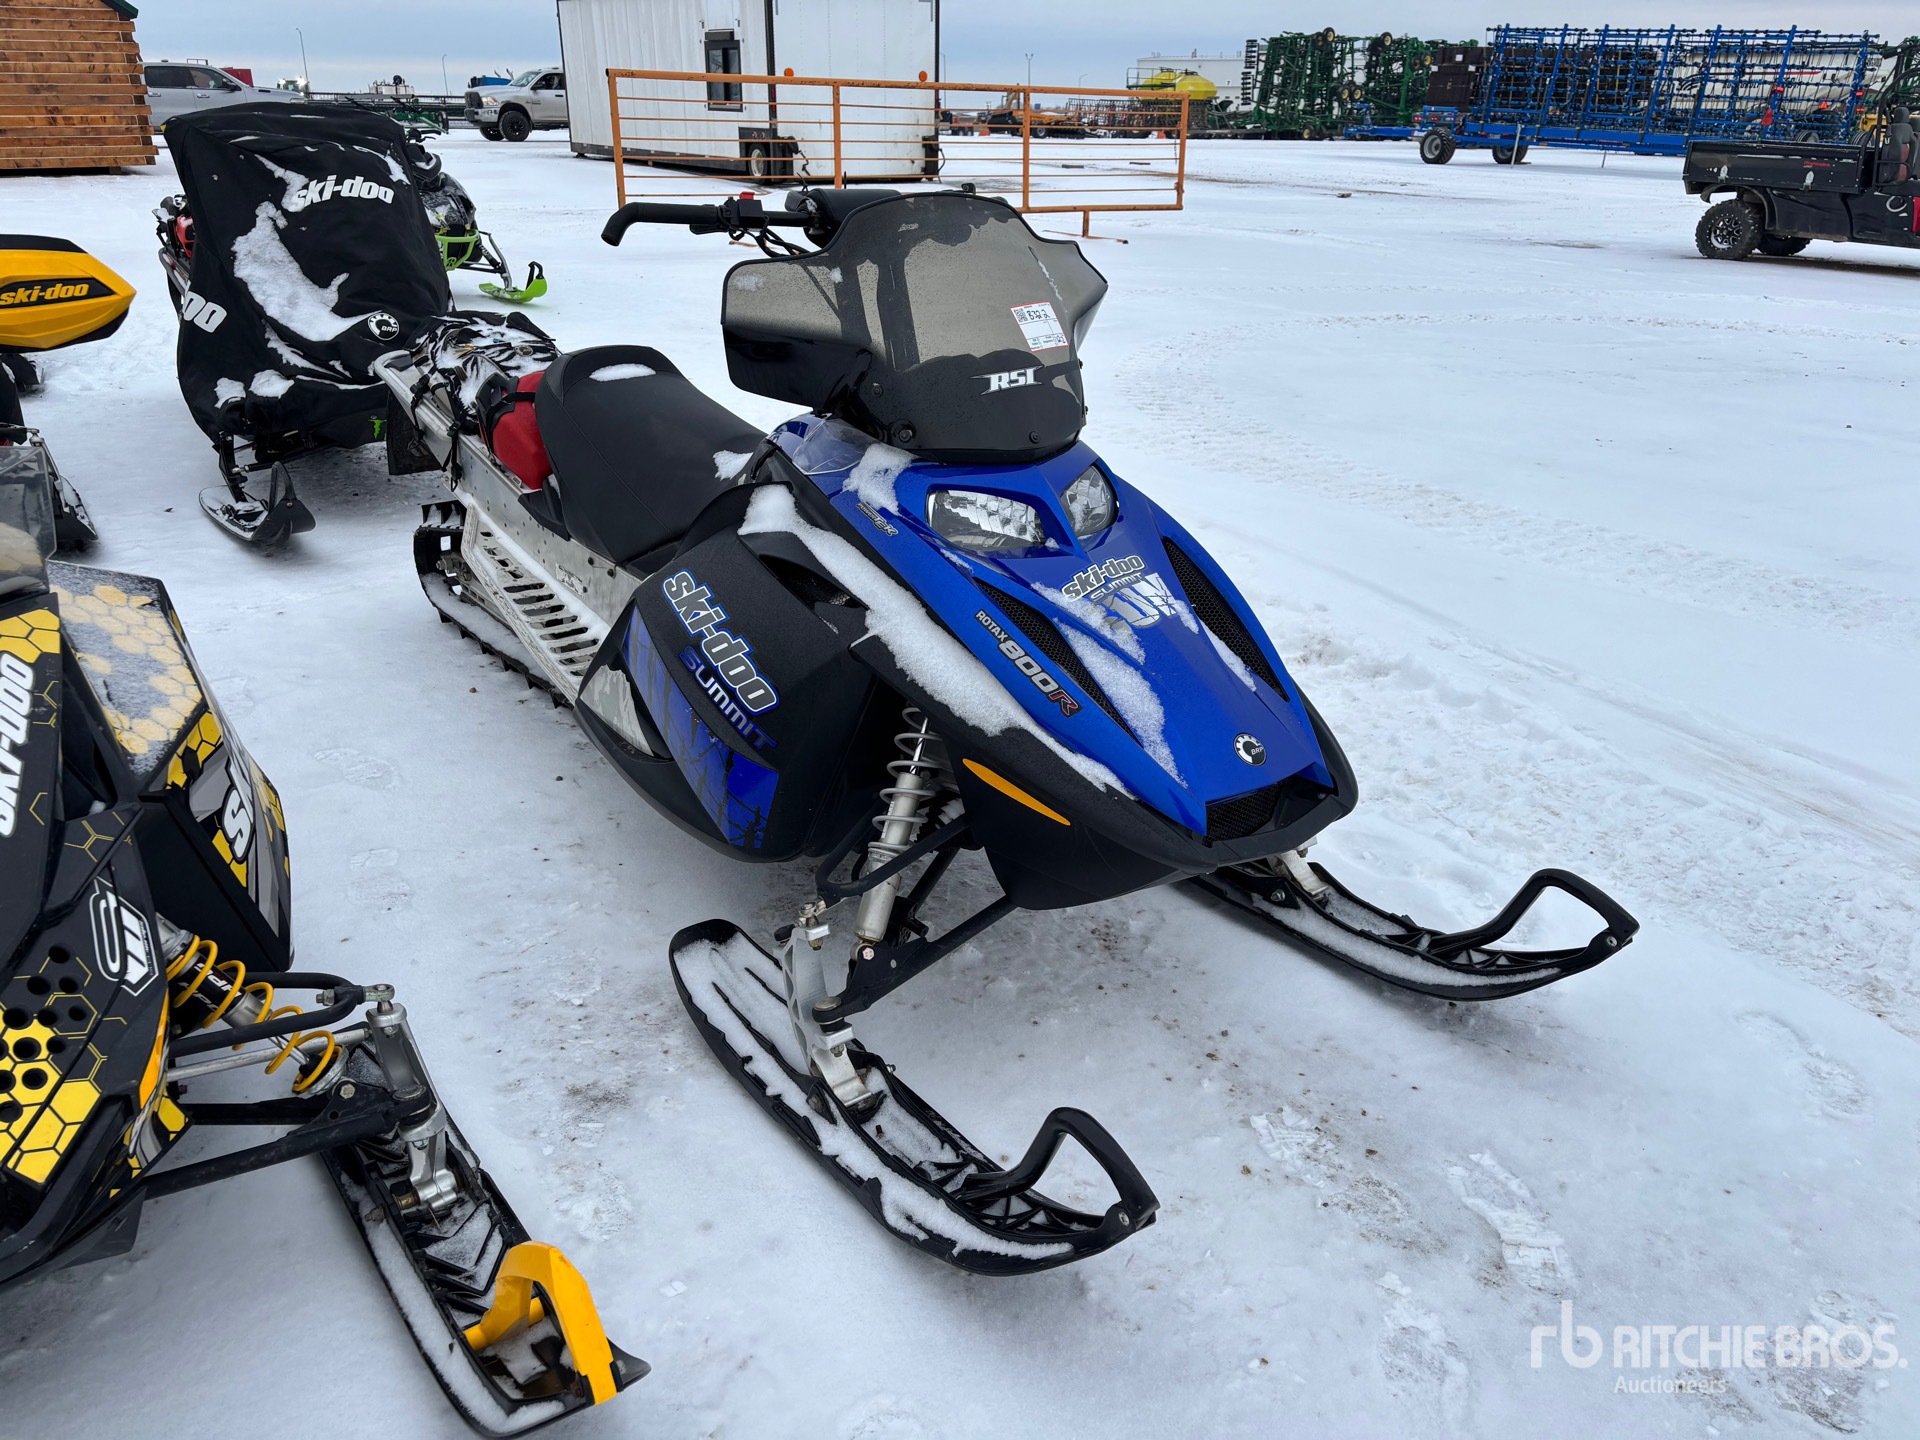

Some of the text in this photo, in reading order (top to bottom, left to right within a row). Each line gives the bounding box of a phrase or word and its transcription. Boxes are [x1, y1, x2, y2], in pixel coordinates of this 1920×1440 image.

[0, 283, 89, 306] ski-doo
[981, 366, 1043, 394] RSI
[1062, 555, 1145, 601] ski-doo
[1091, 572, 1143, 600] SUMMIT
[975, 610, 1009, 642] ROTAX
[662, 570, 778, 714] ski-doo
[678, 646, 777, 749] SUMMIT
[1250, 747, 1264, 755] BRP
